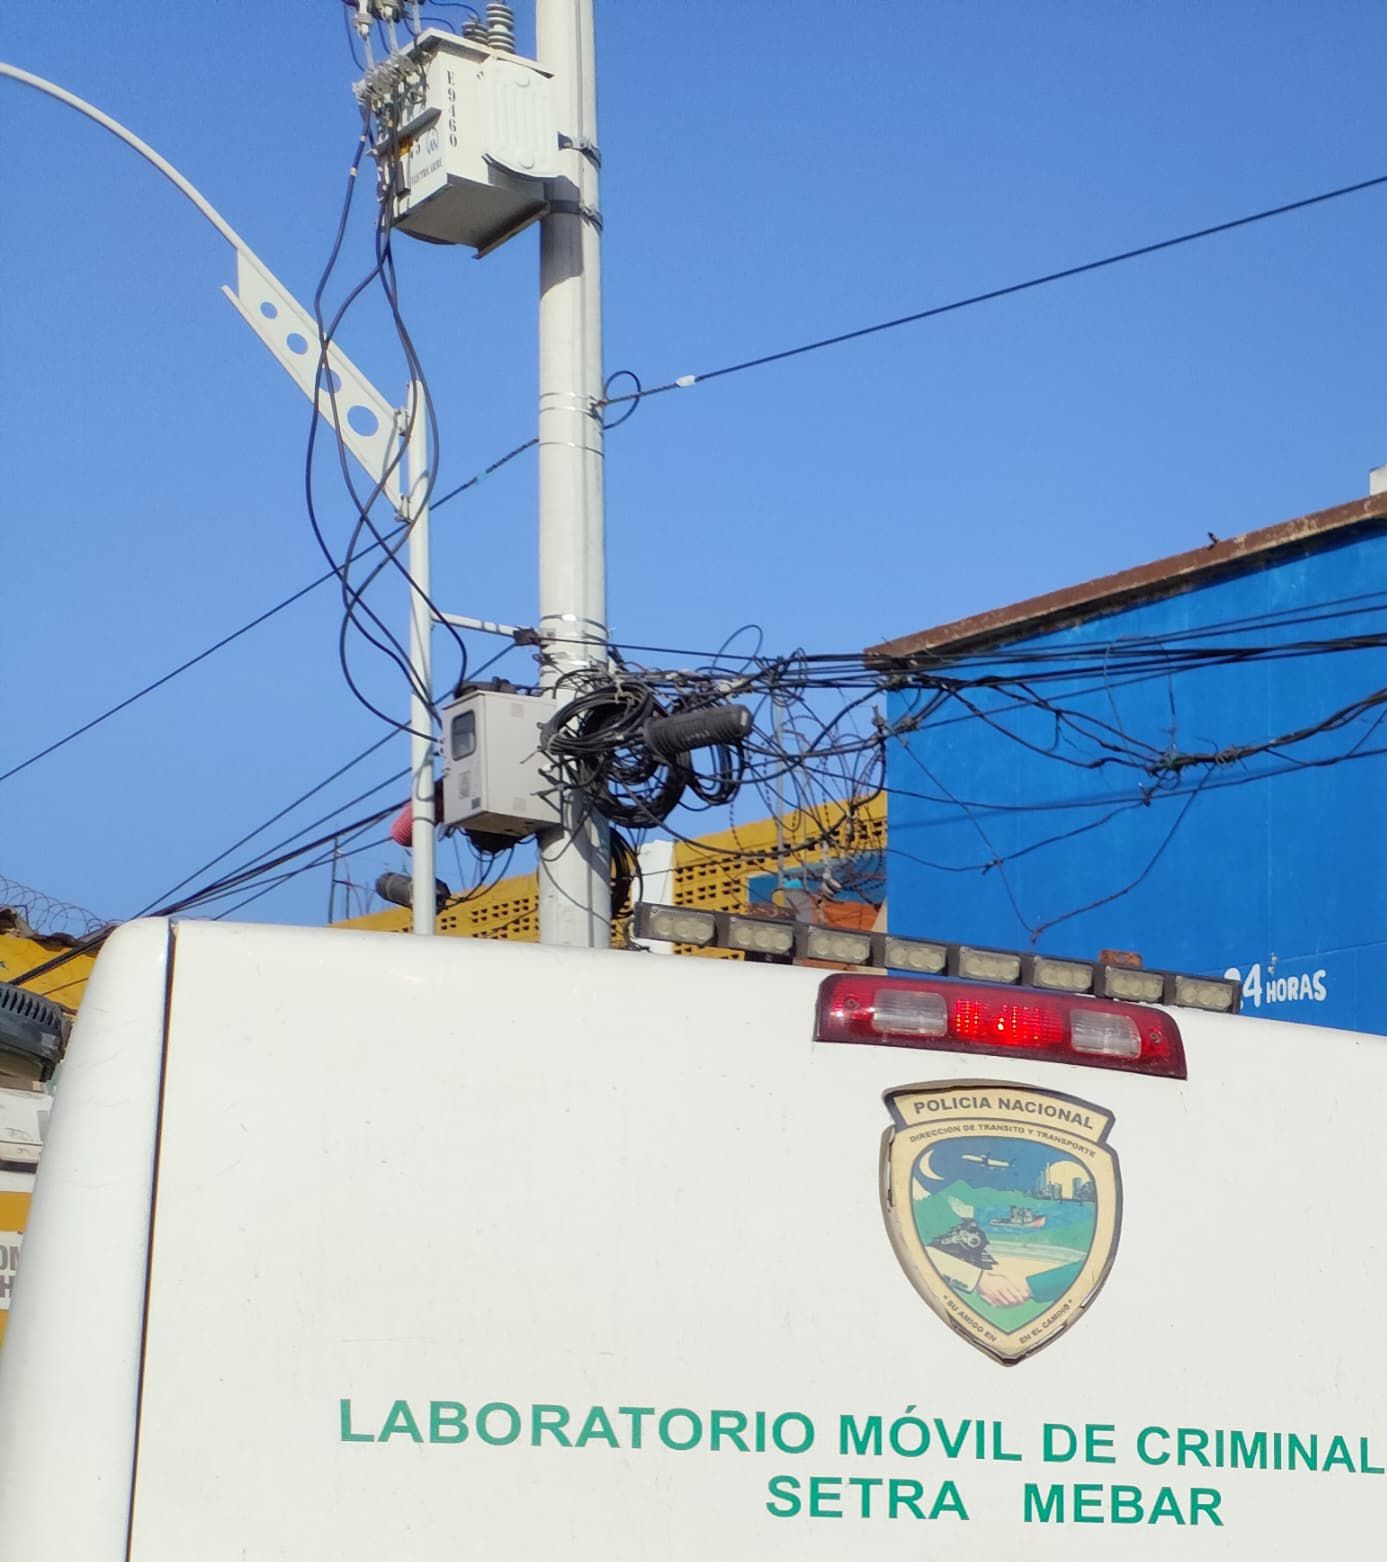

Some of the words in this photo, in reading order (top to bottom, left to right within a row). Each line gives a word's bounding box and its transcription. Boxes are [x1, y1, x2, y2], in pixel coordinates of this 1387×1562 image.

[1266, 969, 1327, 1004] HORAS
[914, 1097, 992, 1114] POLICIA
[998, 1098, 1094, 1130] NACIONAL
[978, 1124, 1025, 1134] TRANSITO
[1027, 1127, 1034, 1135] Y
[1036, 1130, 1097, 1158] TRANSPORTE
[947, 1300, 958, 1312] SU
[958, 1310, 984, 1333] AMIGO
[984, 1331, 998, 1342] EN
[1019, 1334, 1032, 1344] EN
[1031, 1327, 1042, 1336] EL
[339, 1398, 816, 1455] LABORATORIO
[838, 1404, 1022, 1461] MÓVIL
[1042, 1422, 1117, 1464] DE
[765, 1475, 970, 1521] SETRA
[1022, 1482, 1225, 1527] MEBAR
